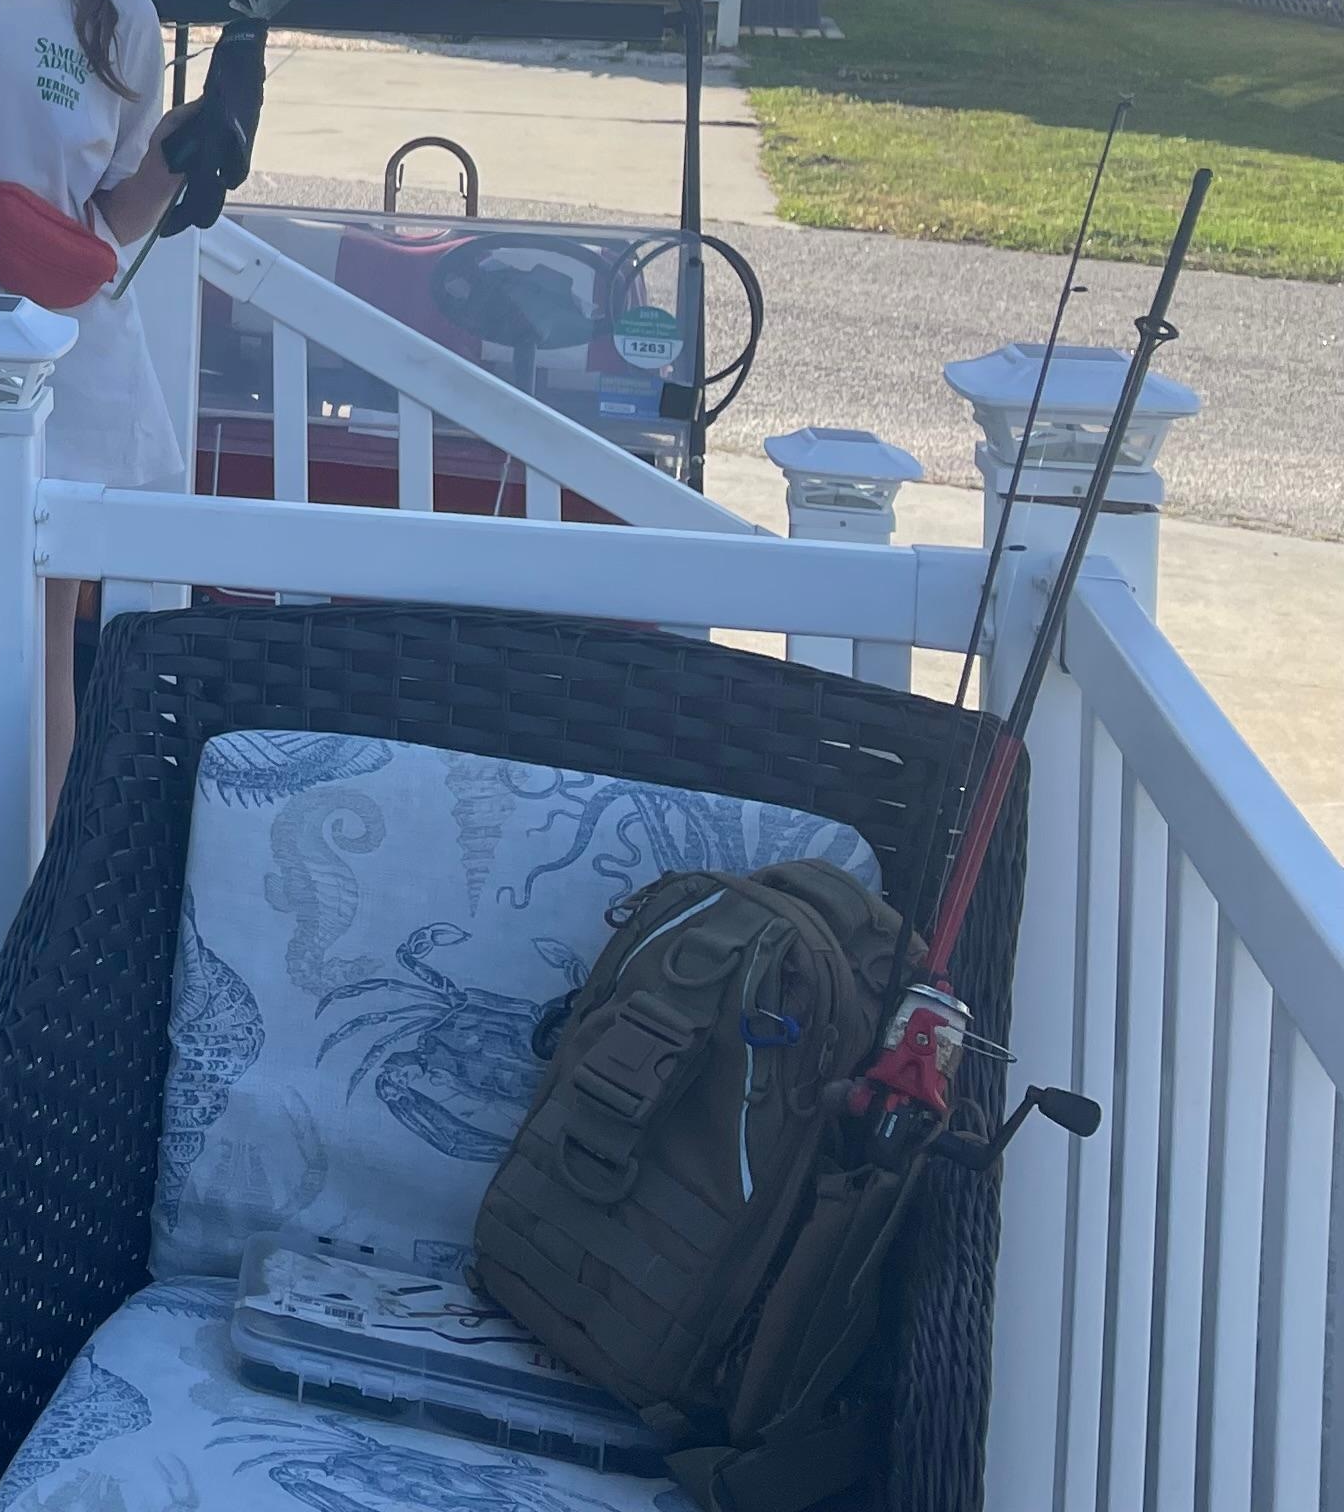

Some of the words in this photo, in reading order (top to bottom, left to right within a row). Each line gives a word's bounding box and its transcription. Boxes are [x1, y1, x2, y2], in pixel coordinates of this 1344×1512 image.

[34, 36, 95, 73] SAMUE
[37, 54, 88, 85] ADAMS
[36, 75, 81, 103] DERRICK
[40, 88, 75, 111] WHITE
